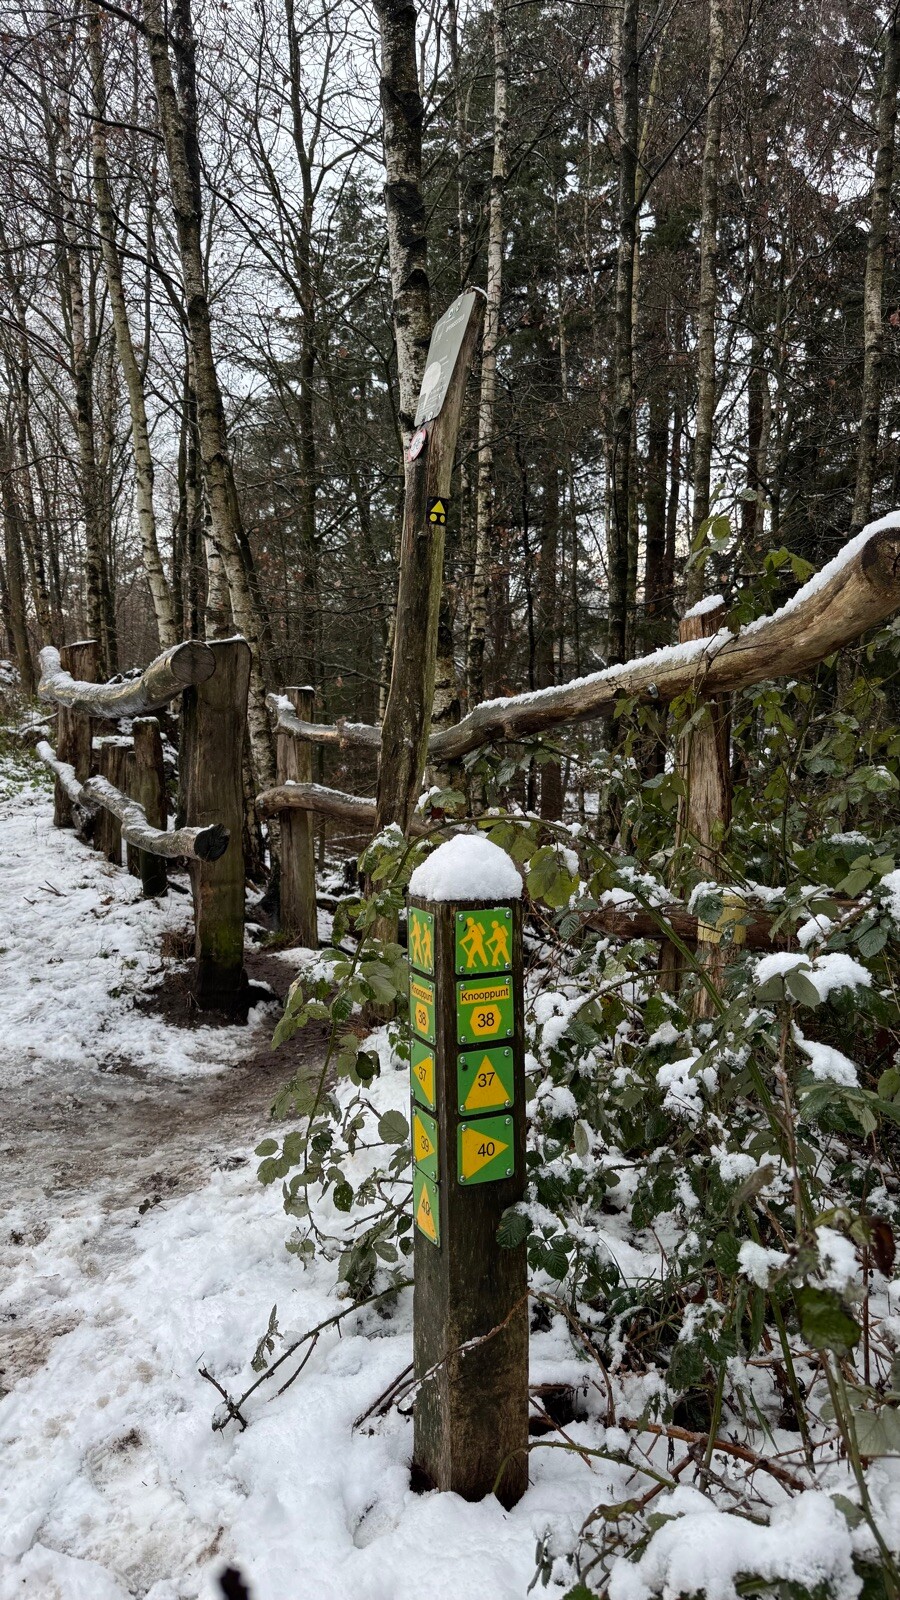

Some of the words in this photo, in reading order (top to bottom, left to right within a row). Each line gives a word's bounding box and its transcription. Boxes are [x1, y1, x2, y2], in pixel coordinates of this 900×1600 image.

[461, 988, 509, 1002] Knooppunt
[418, 1010, 426, 1026] 38
[478, 1012, 494, 1028] 38
[418, 1066, 426, 1082] 37
[478, 1072, 495, 1088] 37
[420, 1136, 430, 1152] 39
[478, 1142, 495, 1157] 40
